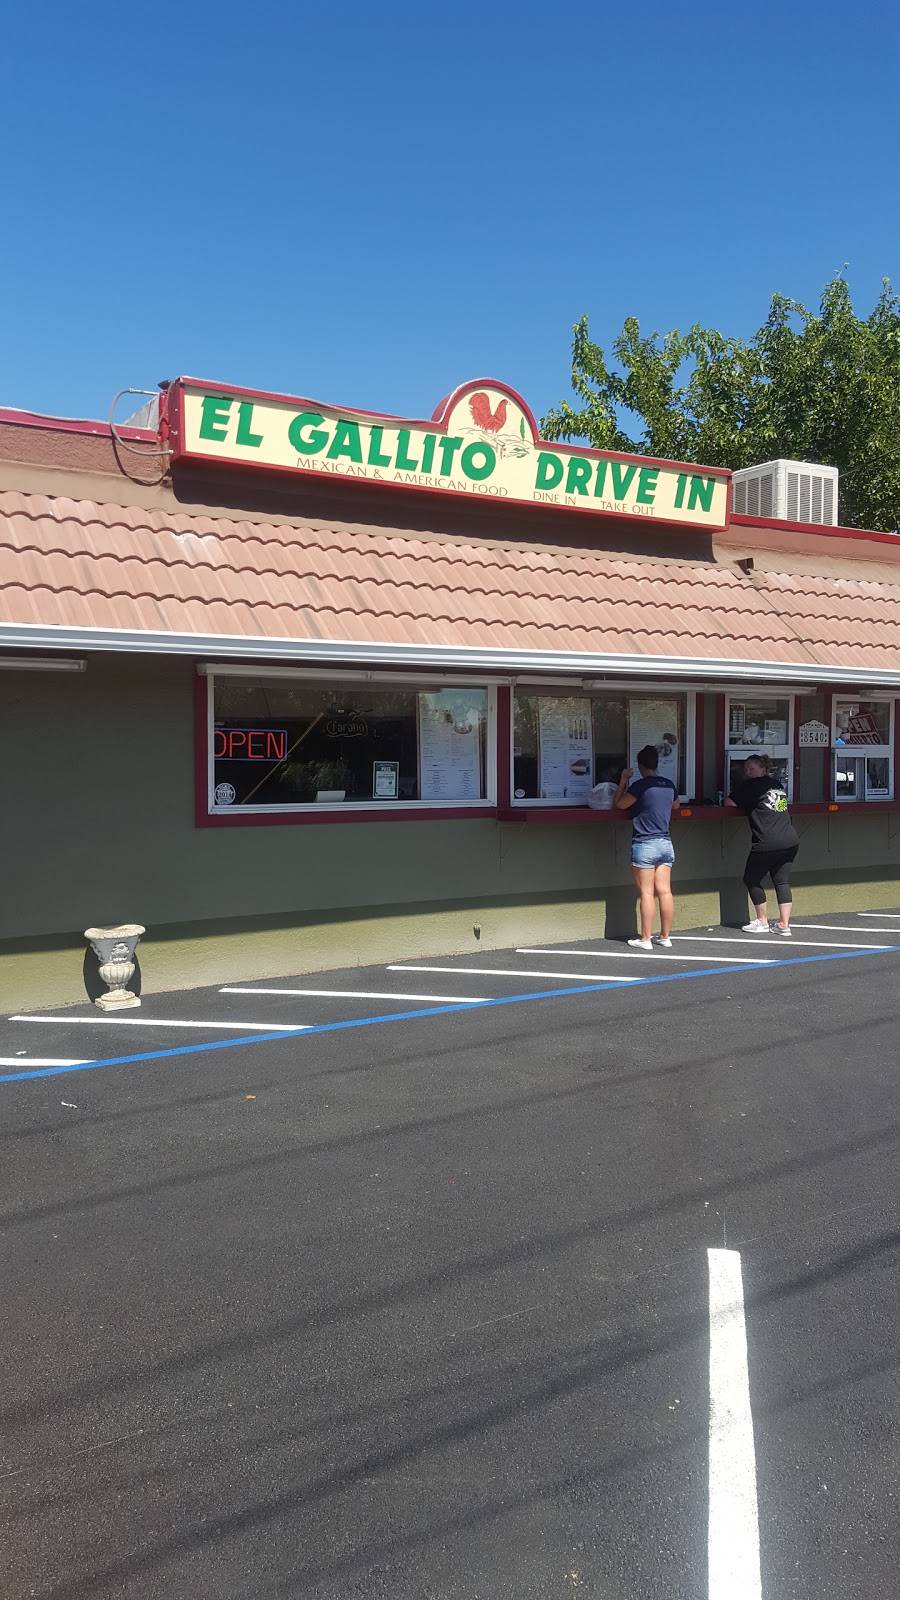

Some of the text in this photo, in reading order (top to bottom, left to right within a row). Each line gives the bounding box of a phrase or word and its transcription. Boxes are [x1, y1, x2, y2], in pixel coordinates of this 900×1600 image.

[199, 395, 716, 513] EL GALLITO DRIVE IN
[296, 456, 508, 497] MEXICAN & AMERICAN FOOD
[533, 490, 577, 505] DINE IN
[600, 500, 655, 516] TAKE OUT
